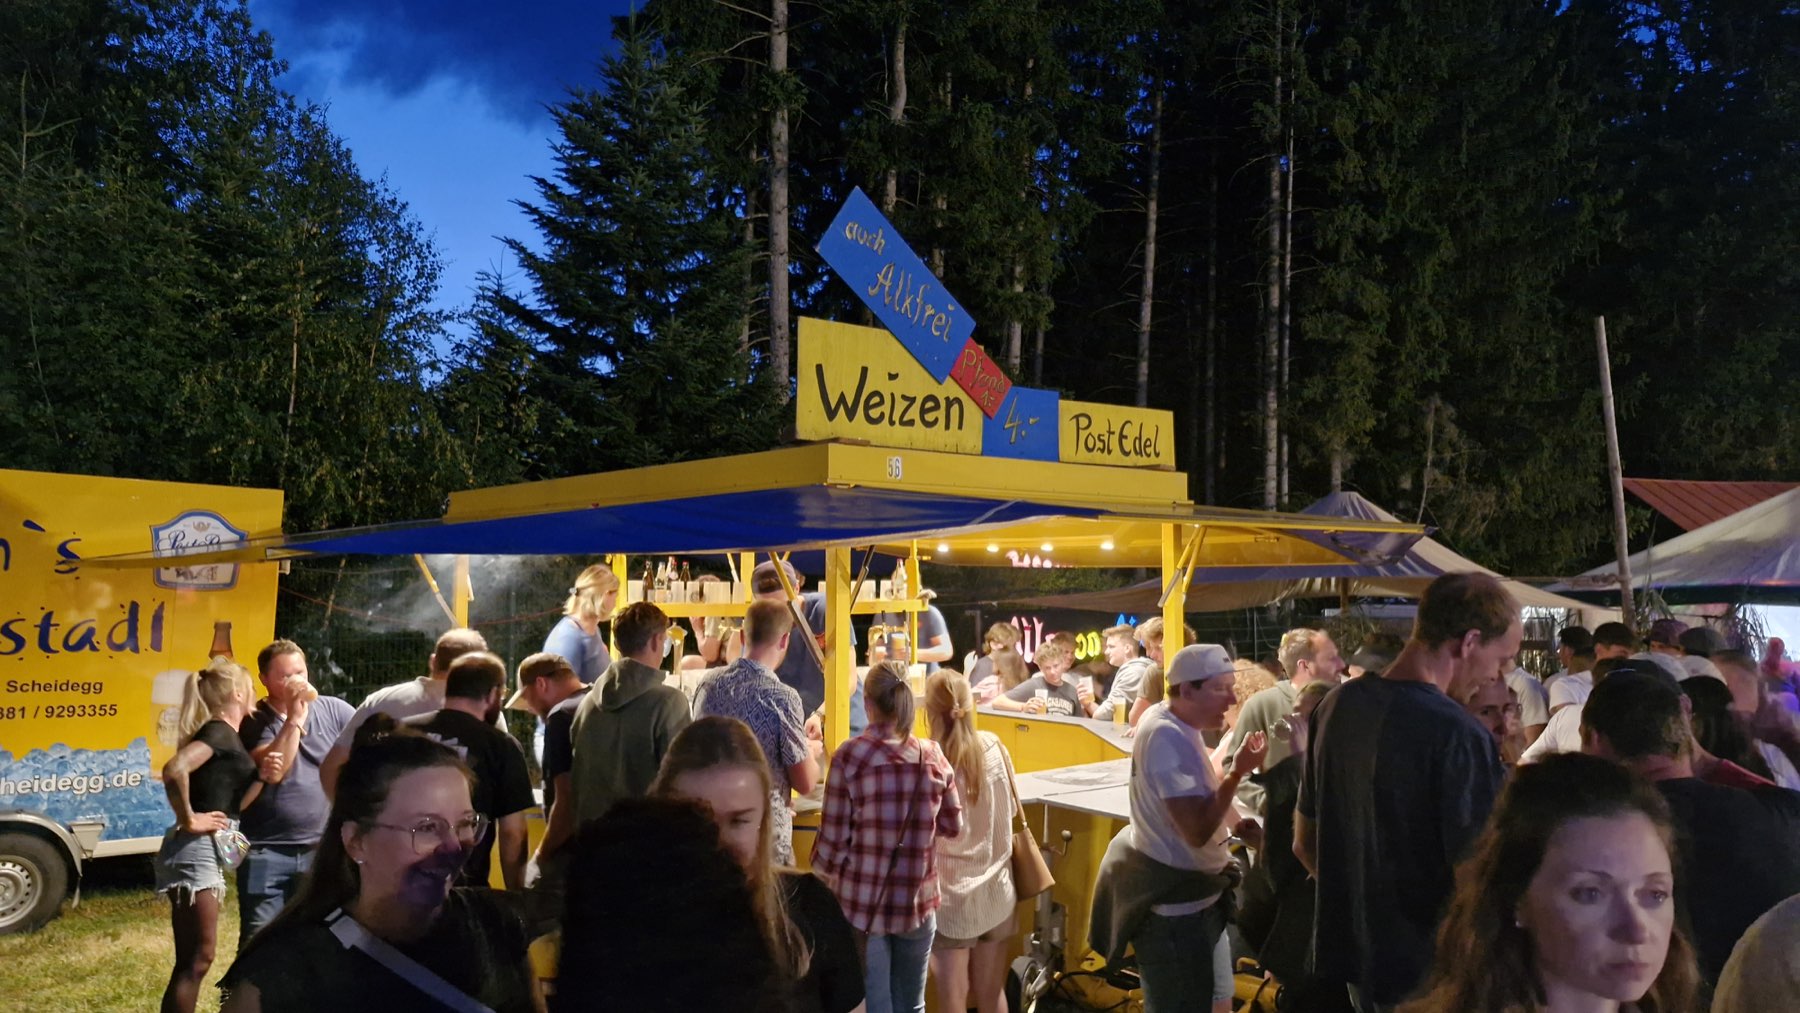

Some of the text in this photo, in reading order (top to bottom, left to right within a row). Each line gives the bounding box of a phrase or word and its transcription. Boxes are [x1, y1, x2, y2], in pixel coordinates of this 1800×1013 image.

[845, 221, 886, 256] auch
[868, 262, 956, 343] Alkfrei
[959, 349, 1006, 393] Pfand
[815, 363, 965, 431] Weizen
[887, 457, 901, 479] 56
[0, 600, 165, 655] stadl
[6, 680, 104, 694] Scheidegg
[45, 704, 118, 719] 9293355
[0, 769, 142, 795] heidegg.de
